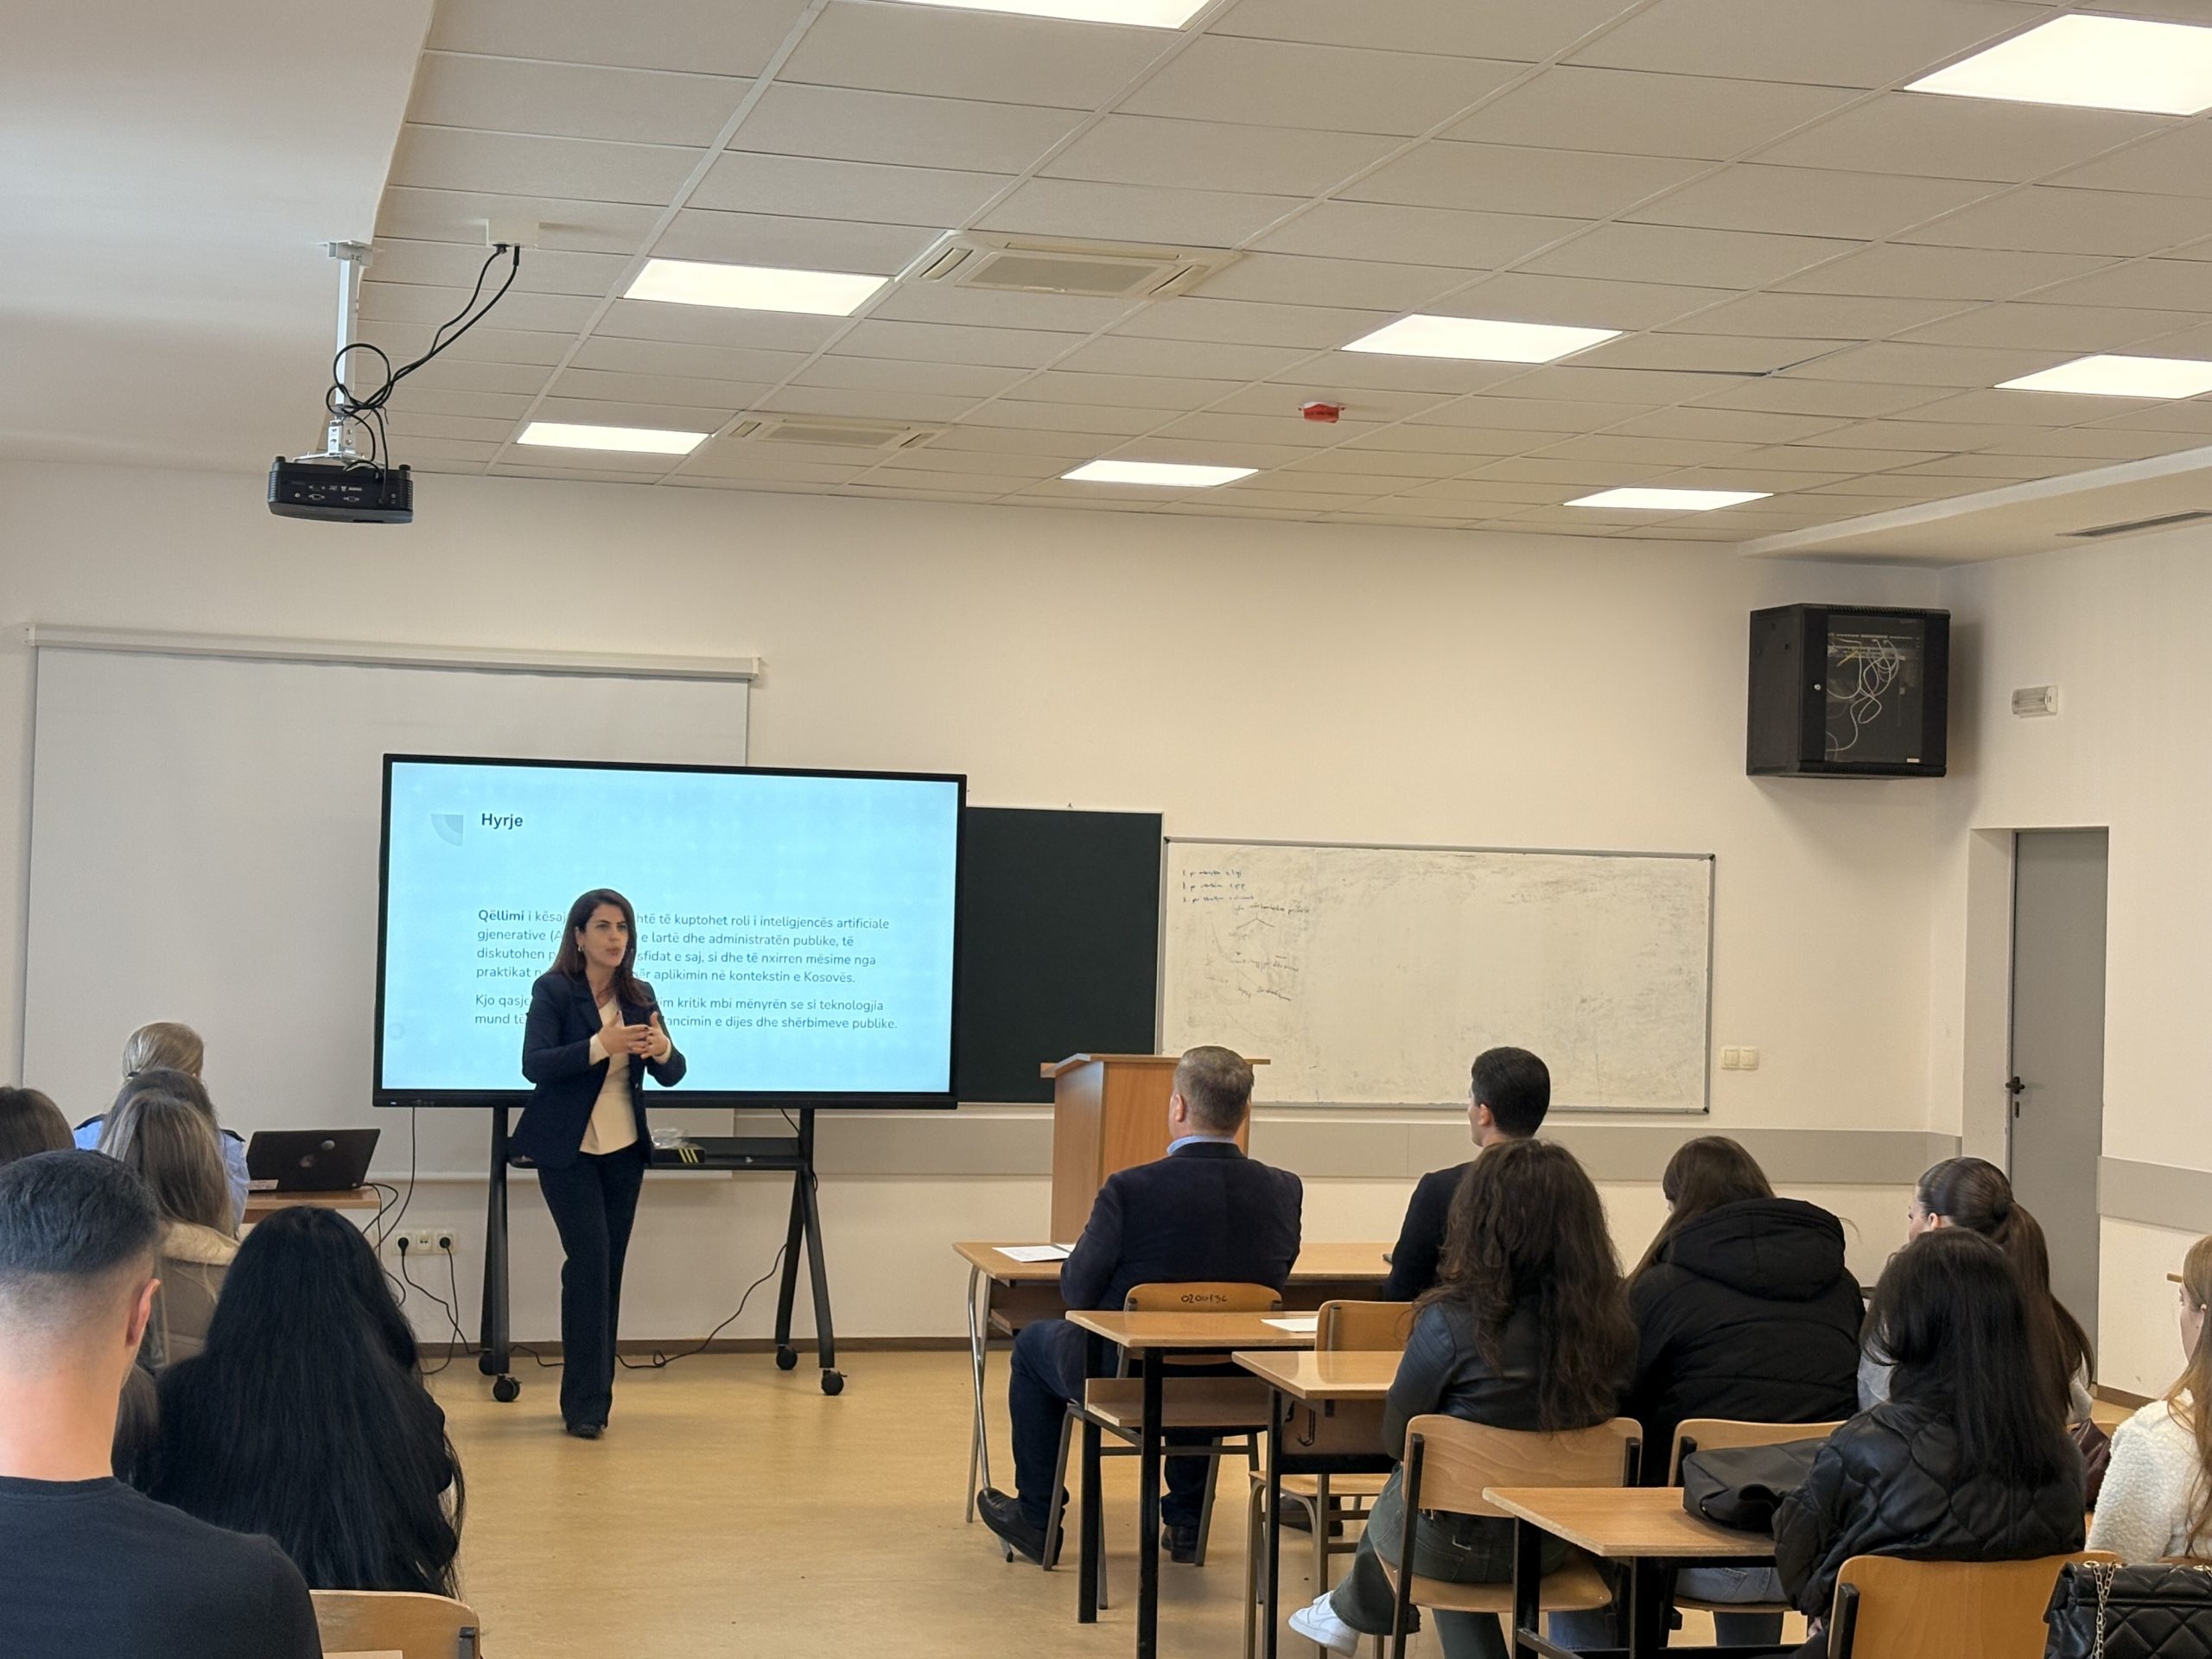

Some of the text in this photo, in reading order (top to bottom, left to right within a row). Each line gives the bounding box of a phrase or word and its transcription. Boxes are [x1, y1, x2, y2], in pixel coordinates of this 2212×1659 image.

[481, 812, 524, 830] Hyrje
[478, 909, 524, 923] Qëllimi
[535, 910, 566, 924] kësaj
[658, 913, 671, 925] të
[674, 913, 728, 927] kuptohet
[731, 914, 750, 926] roli
[760, 915, 834, 930] inteligjencës
[836, 918, 889, 930] artificiale
[477, 928, 546, 942] gjenerative
[640, 934, 649, 944] e
[652, 931, 680, 944] lartë
[683, 932, 706, 944] dhe
[709, 932, 790, 945] administratën
[793, 935, 839, 948] publike,
[842, 936, 854, 947] të
[476, 947, 545, 960] diskutohen
[637, 949, 671, 962] sfidat
[674, 953, 682, 962] e
[684, 952, 705, 964] saj,
[708, 950, 718, 963] si
[721, 951, 744, 963] dhe
[746, 952, 759, 963] të
[761, 952, 803, 964] nxirren
[805, 953, 852, 965] mësime
[854, 957, 876, 968] nga
[476, 966, 531, 978] praktikat
[654, 969, 708, 982] aplikimin
[711, 970, 726, 981] në
[729, 969, 791, 982] kontekstin
[793, 973, 801, 982] e
[804, 971, 856, 983] Kosovës.
[475, 994, 495, 1007] Kjo
[677, 997, 707, 1008] kritik
[710, 999, 732, 1009] mbi
[735, 999, 787, 1011] mënyrën
[790, 1001, 804, 1010] se
[806, 1000, 817, 1010] si
[819, 1000, 884, 1014] teknologjia
[474, 1013, 511, 1025] mund
[715, 1018, 722, 1027] e
[725, 1016, 753, 1030] dijes
[756, 1016, 779, 1028] dhe
[781, 1017, 849, 1028] shërbimeve
[852, 1018, 898, 1031] publike.
